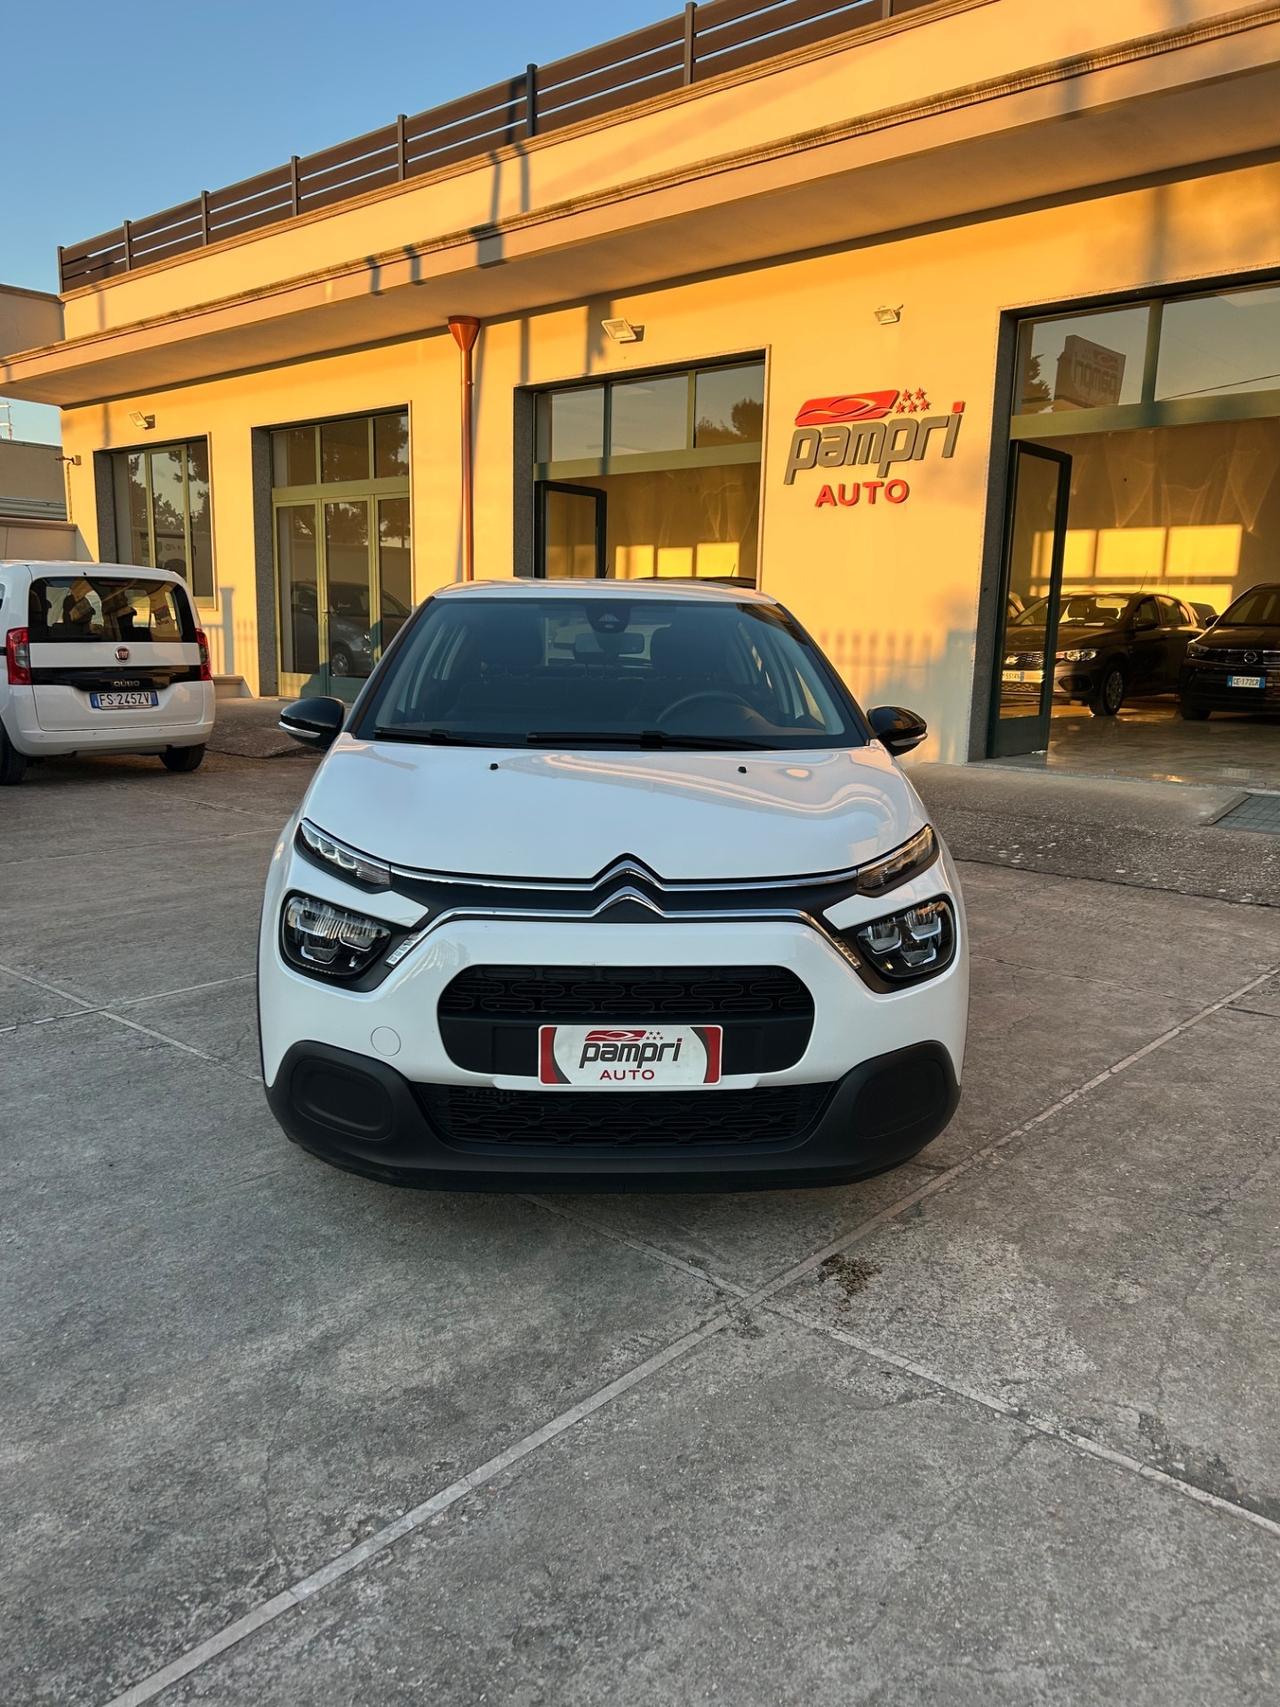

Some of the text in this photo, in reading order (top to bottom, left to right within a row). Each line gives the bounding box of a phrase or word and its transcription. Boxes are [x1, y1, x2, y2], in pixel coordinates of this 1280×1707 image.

[784, 401, 966, 485] pampri
[815, 479, 911, 508] AUTO
[579, 1038, 682, 1069] pampri
[600, 1069, 655, 1081] AUTO
